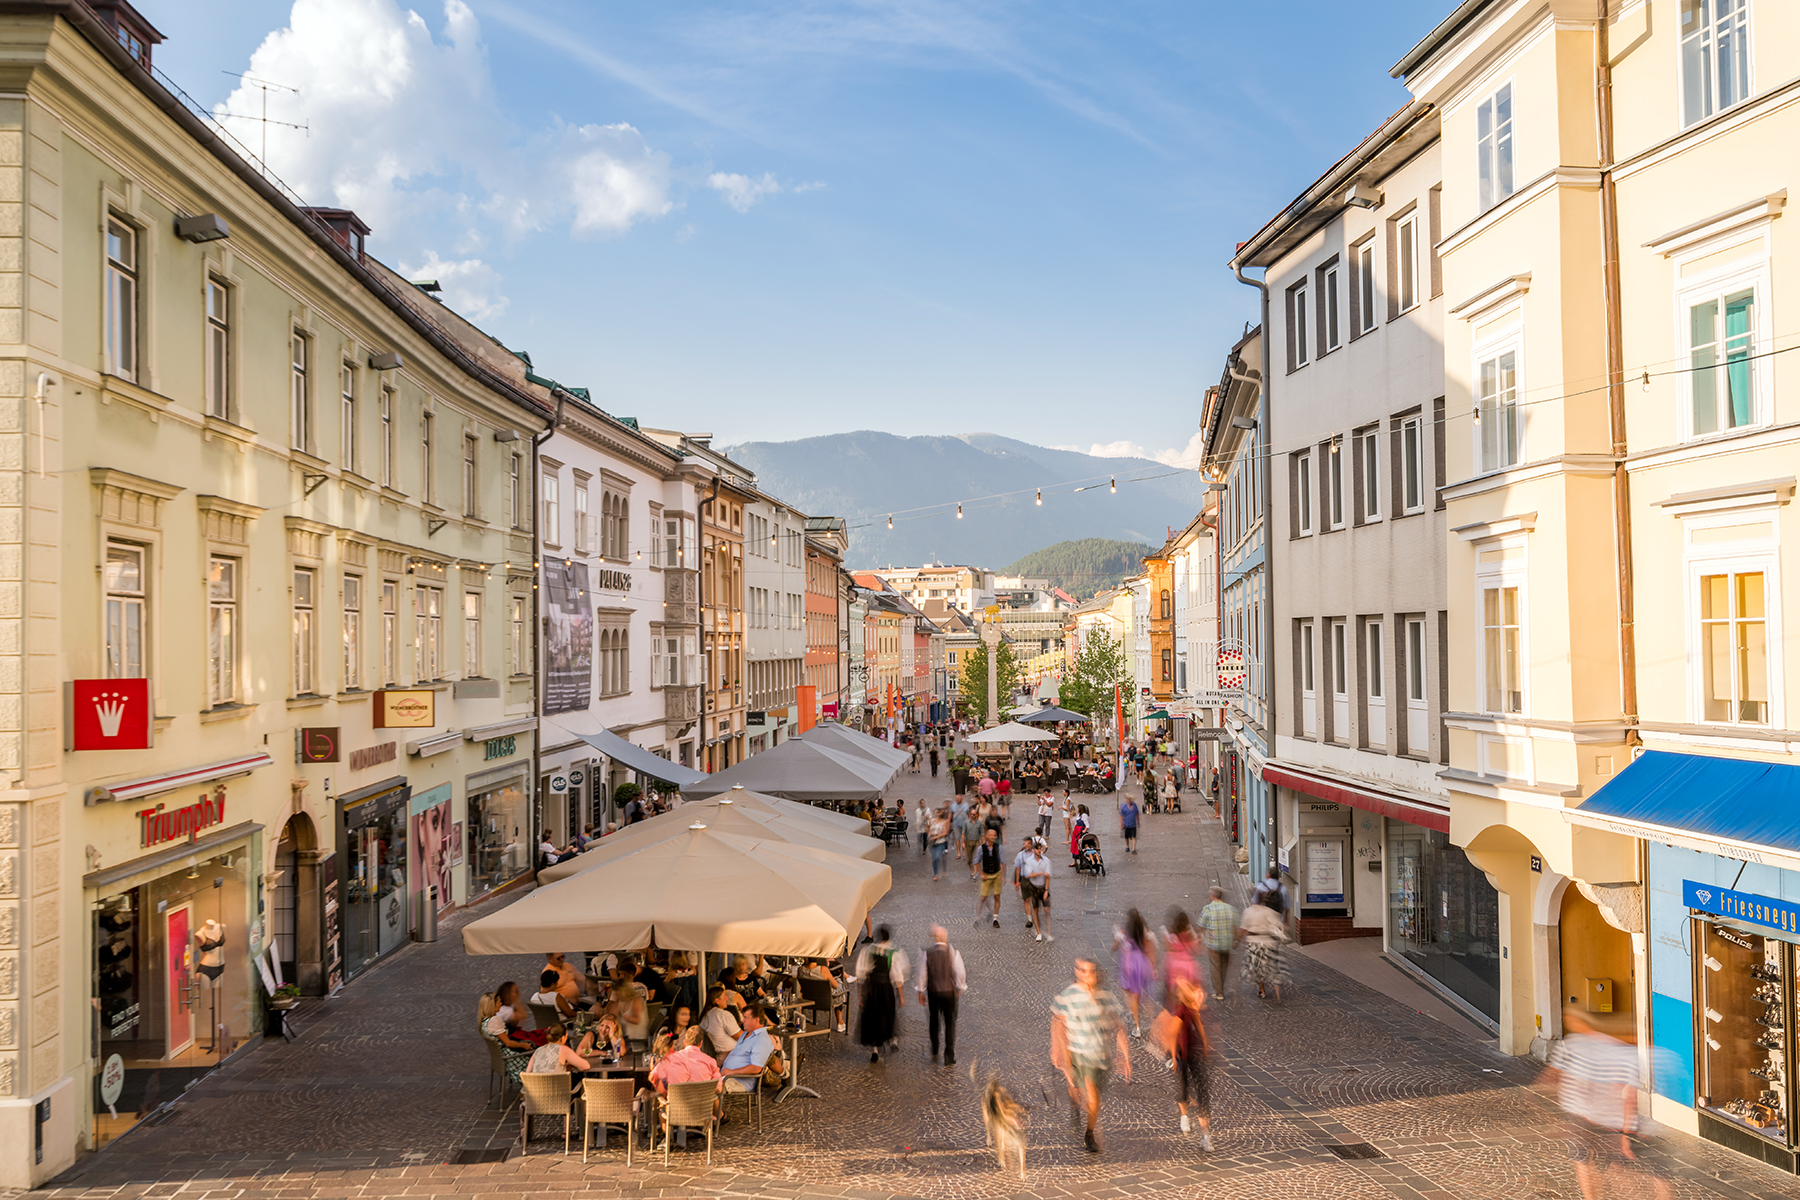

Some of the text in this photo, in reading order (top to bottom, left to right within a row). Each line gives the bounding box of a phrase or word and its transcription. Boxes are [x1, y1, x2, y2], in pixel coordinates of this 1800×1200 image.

[137, 794, 214, 848] Triumph
[1531, 858, 1541, 871] 27
[1720, 892, 1797, 933] Friessnegg
[1718, 929, 1753, 950] POLICE
